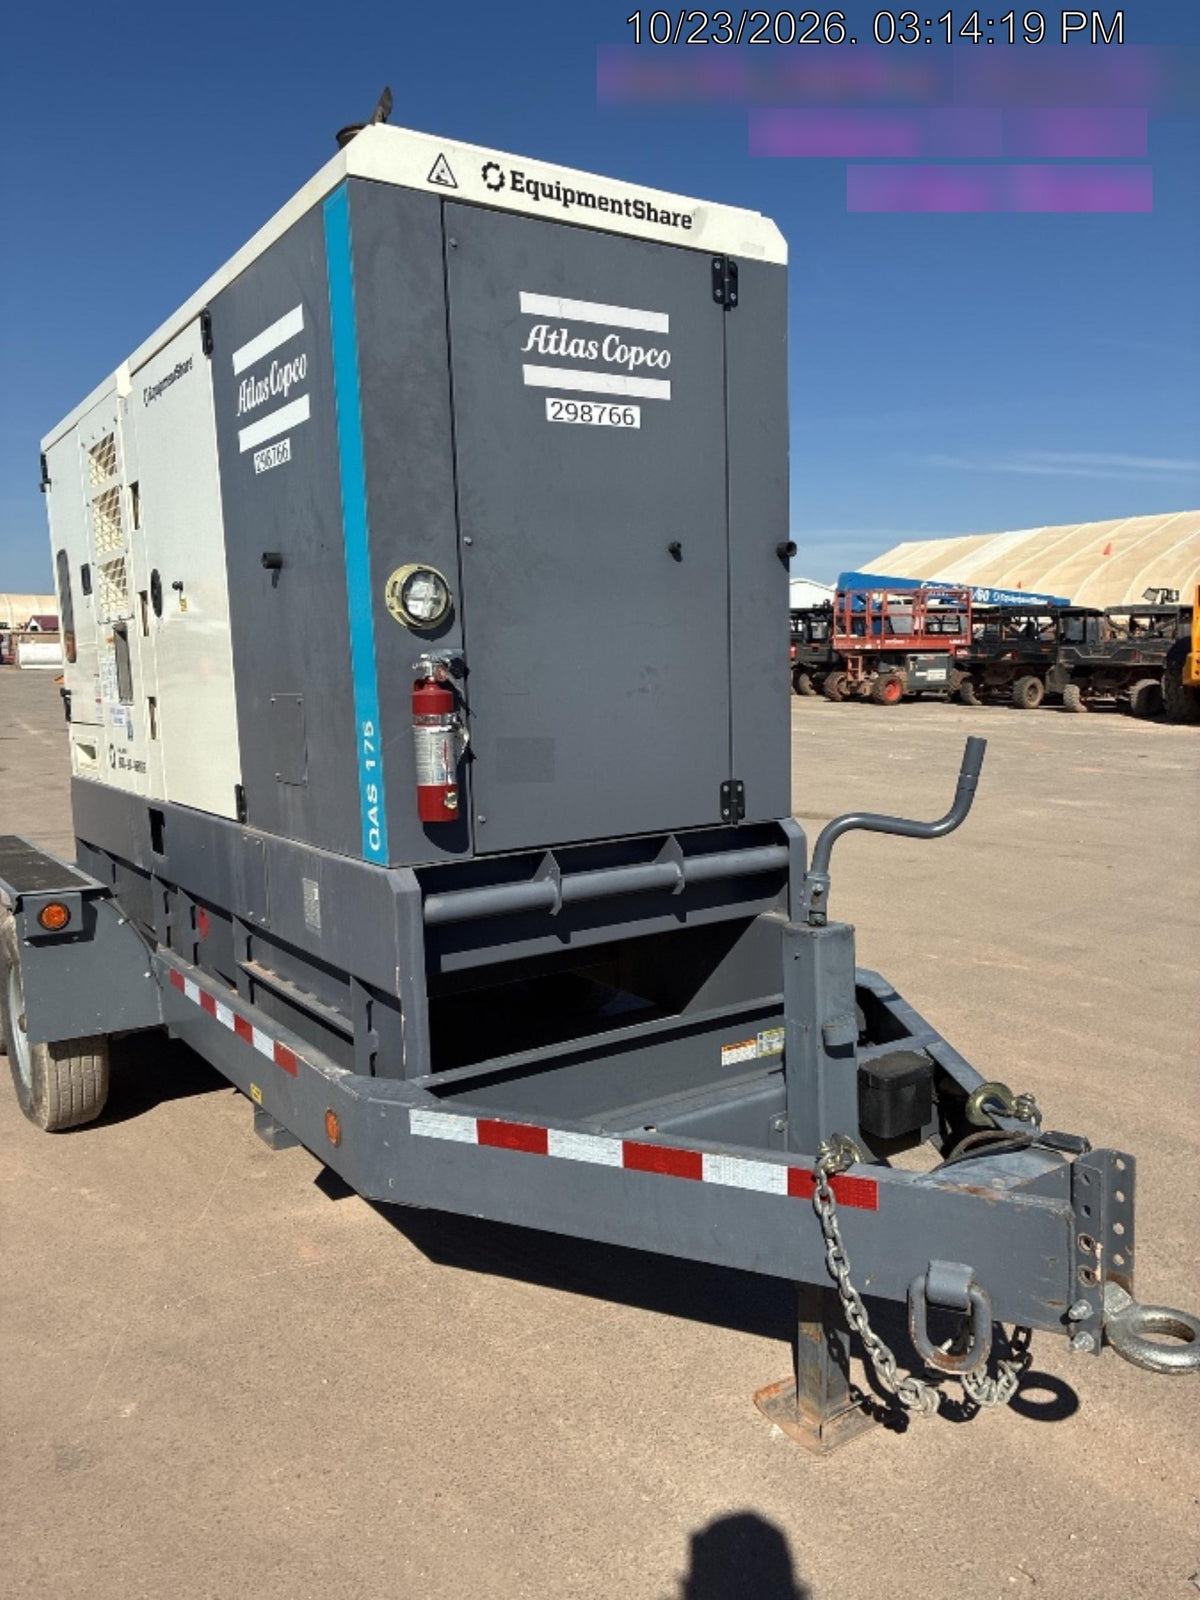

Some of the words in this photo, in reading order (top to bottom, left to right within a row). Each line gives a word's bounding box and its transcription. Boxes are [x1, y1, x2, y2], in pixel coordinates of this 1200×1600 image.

[510, 170, 693, 230] EquipmentShare
[521, 324, 599, 361] Atlas
[602, 332, 671, 371] Copco
[236, 376, 270, 416] Atlas
[269, 353, 308, 398] Copco
[550, 401, 636, 427] 298766
[363, 720, 377, 771] 175
[365, 783, 381, 852] QAS
